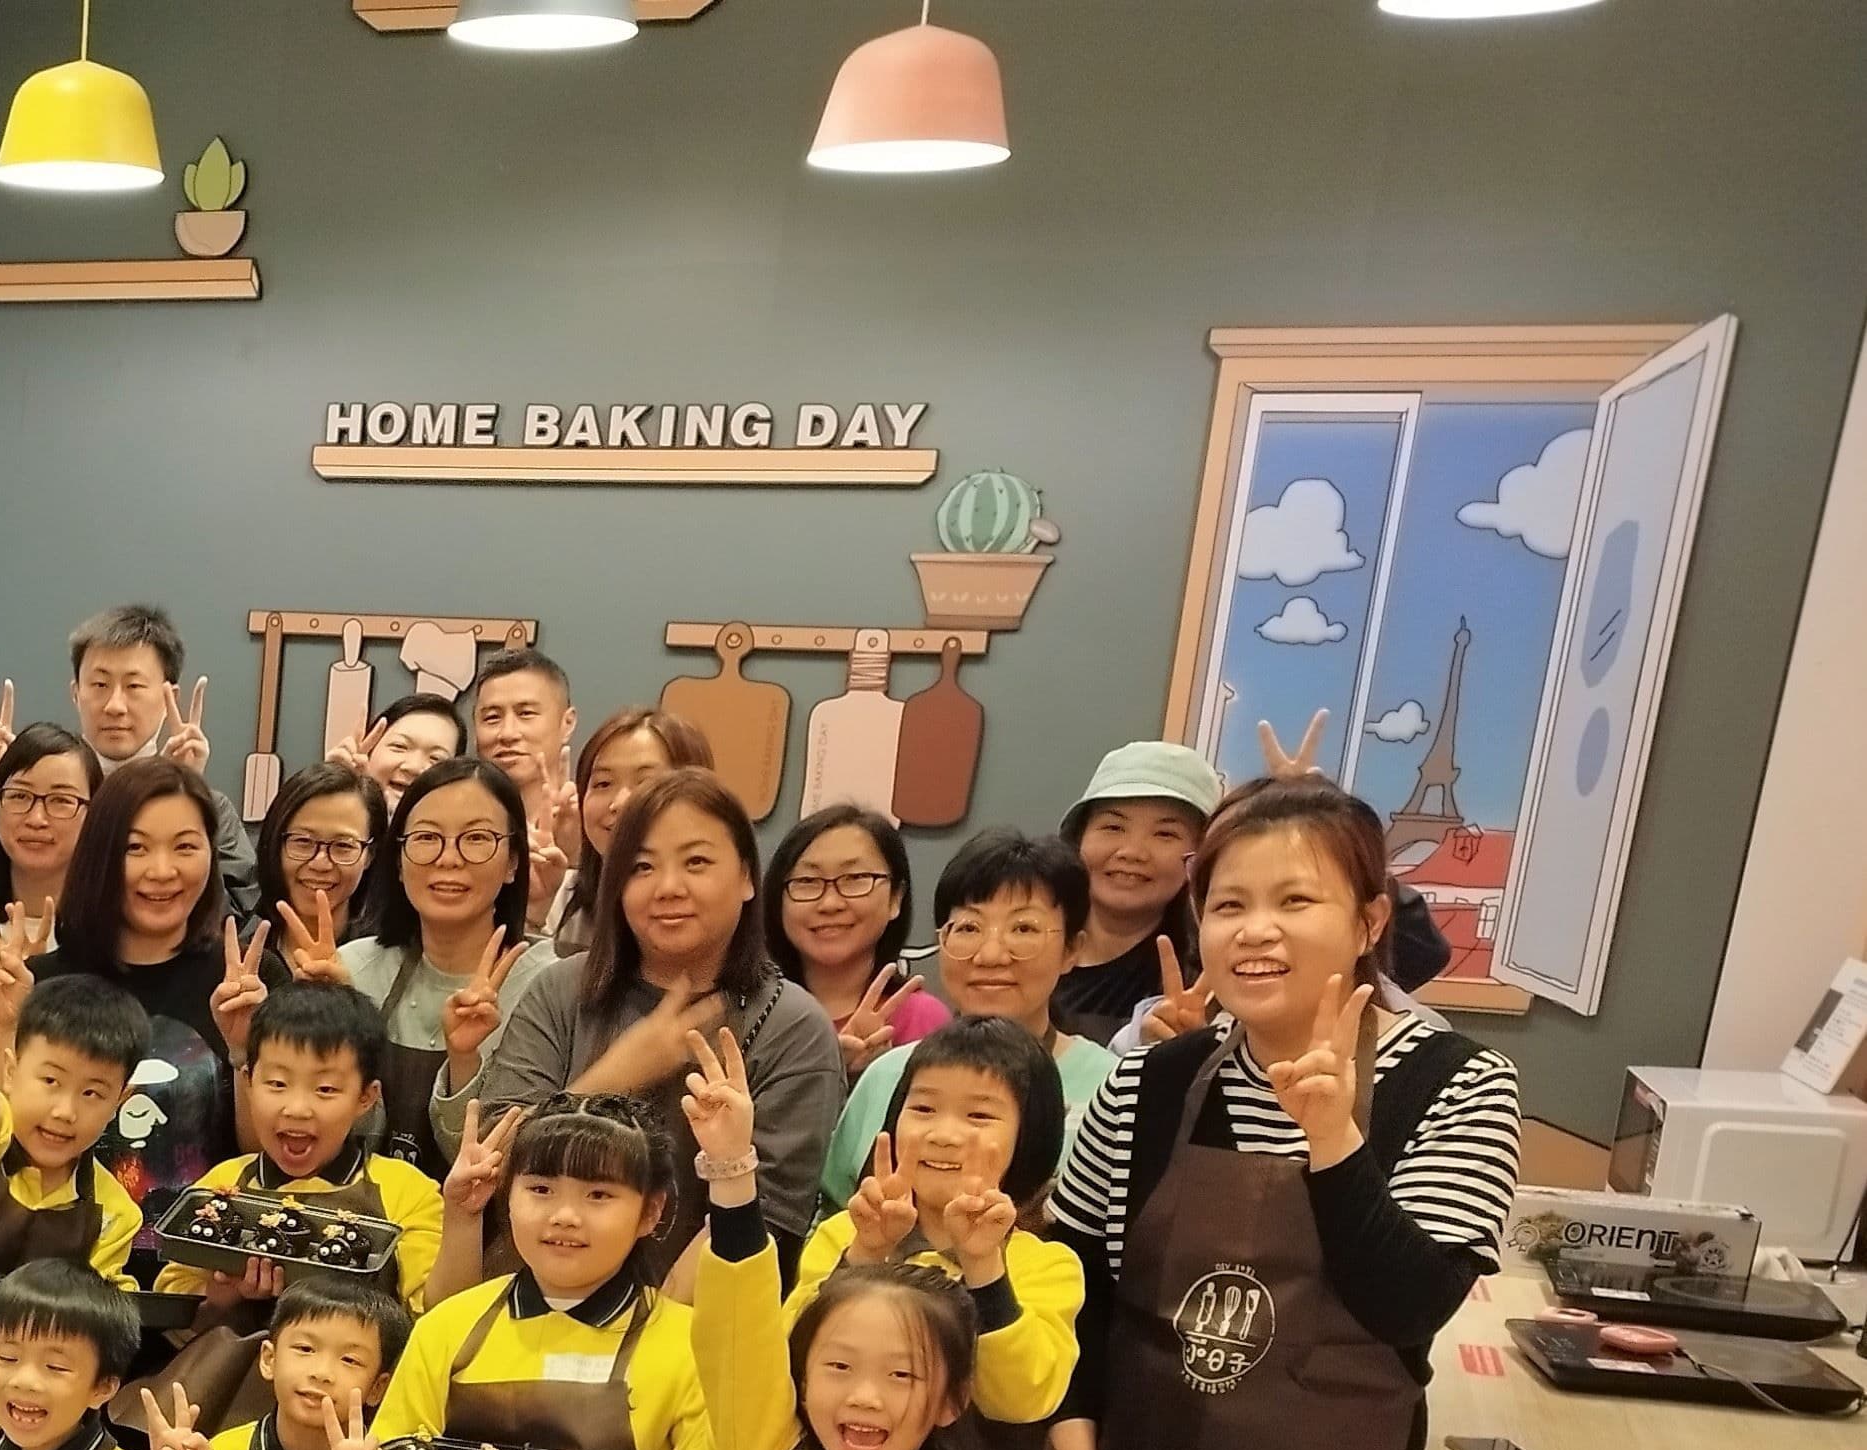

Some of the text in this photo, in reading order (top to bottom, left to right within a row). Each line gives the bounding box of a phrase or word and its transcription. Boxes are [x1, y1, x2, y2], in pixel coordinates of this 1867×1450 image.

[325, 402, 930, 448] HOME BAKING DAY
